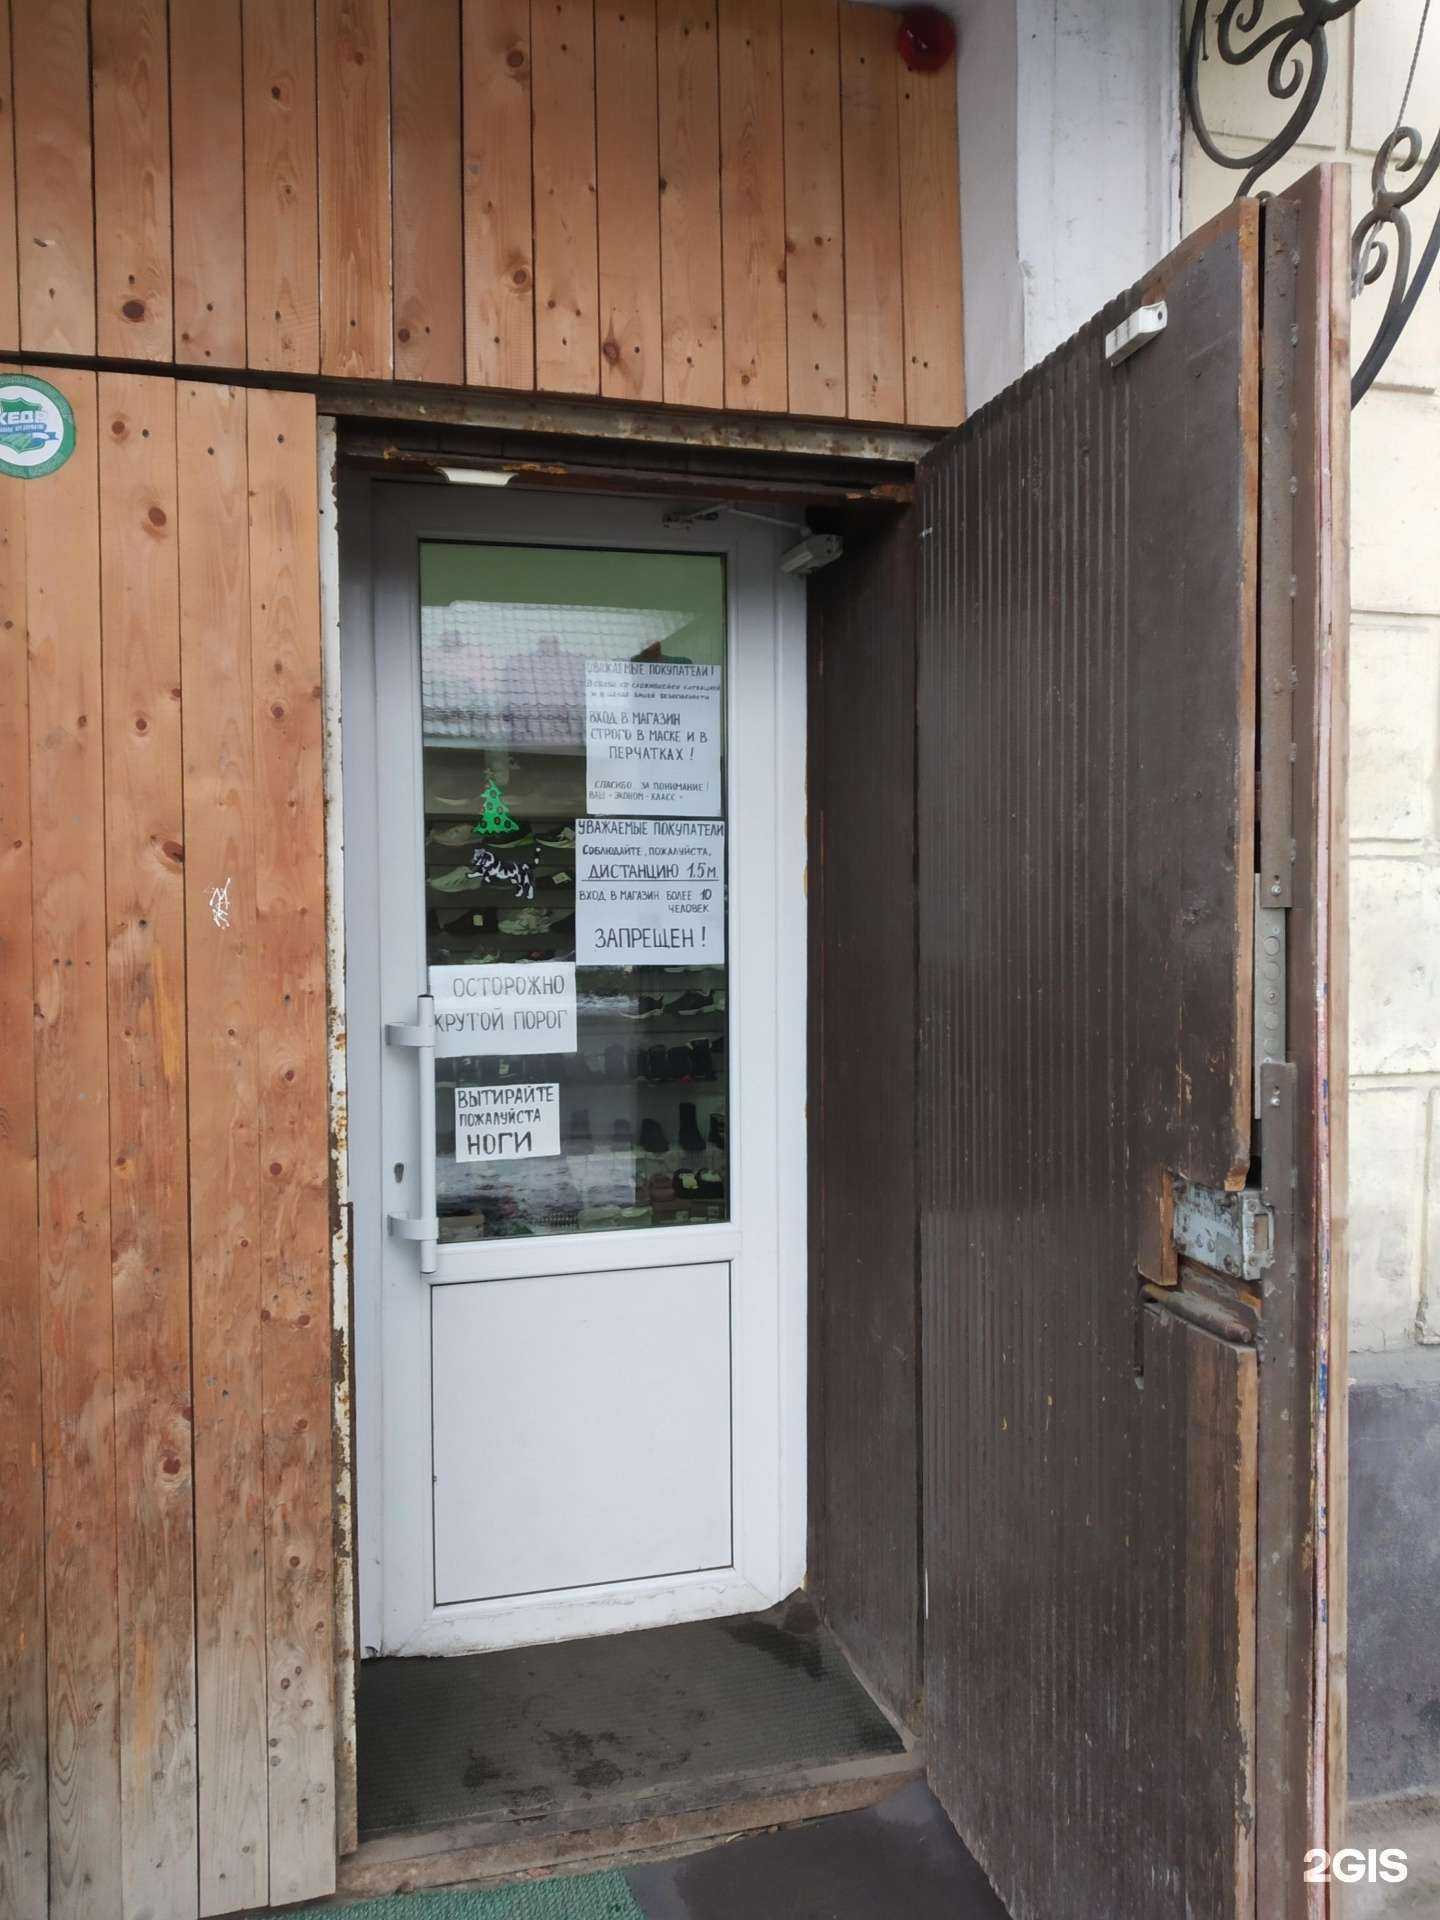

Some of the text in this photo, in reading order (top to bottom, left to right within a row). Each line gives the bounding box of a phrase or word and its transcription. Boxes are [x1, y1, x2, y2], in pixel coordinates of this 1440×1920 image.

[649, 664, 714, 677] ПОКУПАТЕЛИ!
[589, 711, 681, 725] ВХОД В МАГАЗИН
[590, 729, 708, 743] СТРОГО В МАСКЕ И В
[578, 820, 724, 836] УВАЖАЕМЫЕ ПОКУПАТЕЛИ
[589, 864, 679, 879] ДИСТАНЦИЮ
[579, 889, 712, 901] ВХОД В МАГАЗИН БОЛЕЕ 10
[668, 905, 709, 913] ЧЕЛОВЕК
[453, 975, 565, 997] ОСТОРОЖНО
[434, 1008, 567, 1032] КРУТОЙ ПОРОГ
[457, 1086, 554, 1108] ВЫТИРАЙТЕ
[459, 1109, 541, 1127] ПОЖАЛУЙСТА
[467, 1132, 532, 1155] НОГИ
